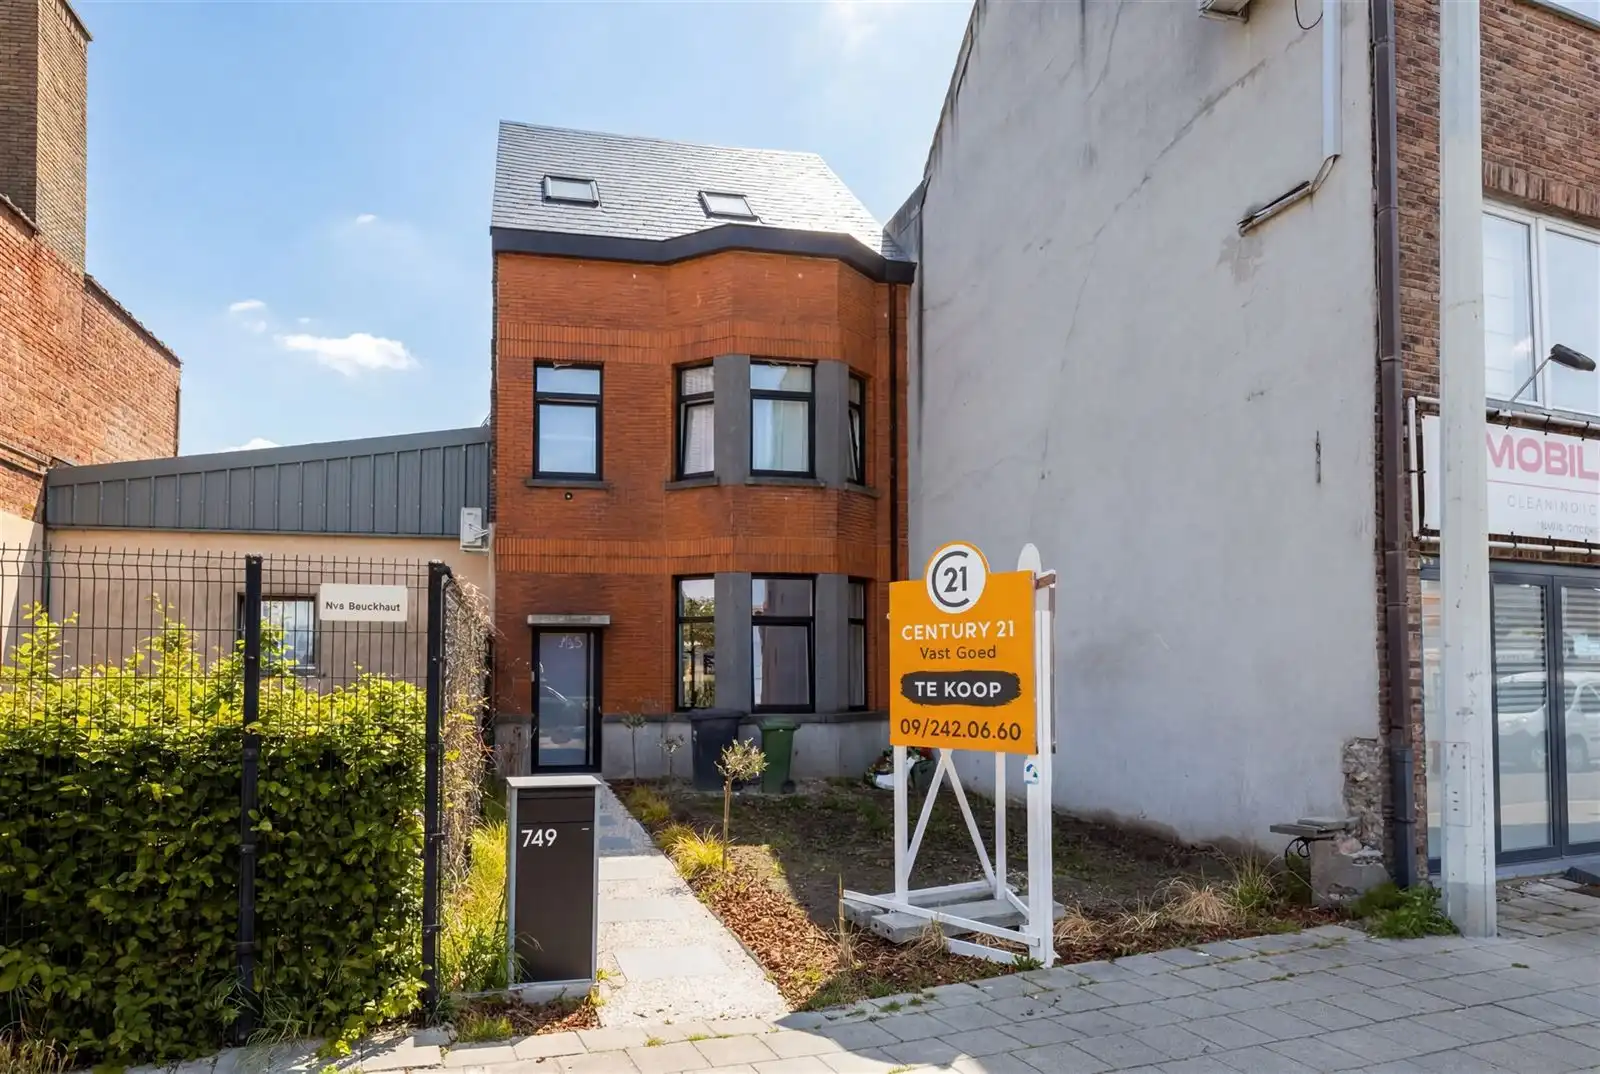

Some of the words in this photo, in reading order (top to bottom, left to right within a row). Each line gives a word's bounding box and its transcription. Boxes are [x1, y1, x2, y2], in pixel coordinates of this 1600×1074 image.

[325, 601, 345, 610] Nvs
[348, 601, 401, 612] Beuckhaut
[901, 621, 991, 641] CENTURY
[996, 620, 1015, 638] 21
[920, 646, 951, 660] Vast
[956, 645, 997, 660] Goed
[915, 681, 937, 697] TE
[944, 681, 1002, 698] KOOP
[900, 718, 1022, 741] 09/242.06.60
[521, 828, 558, 848] 749
